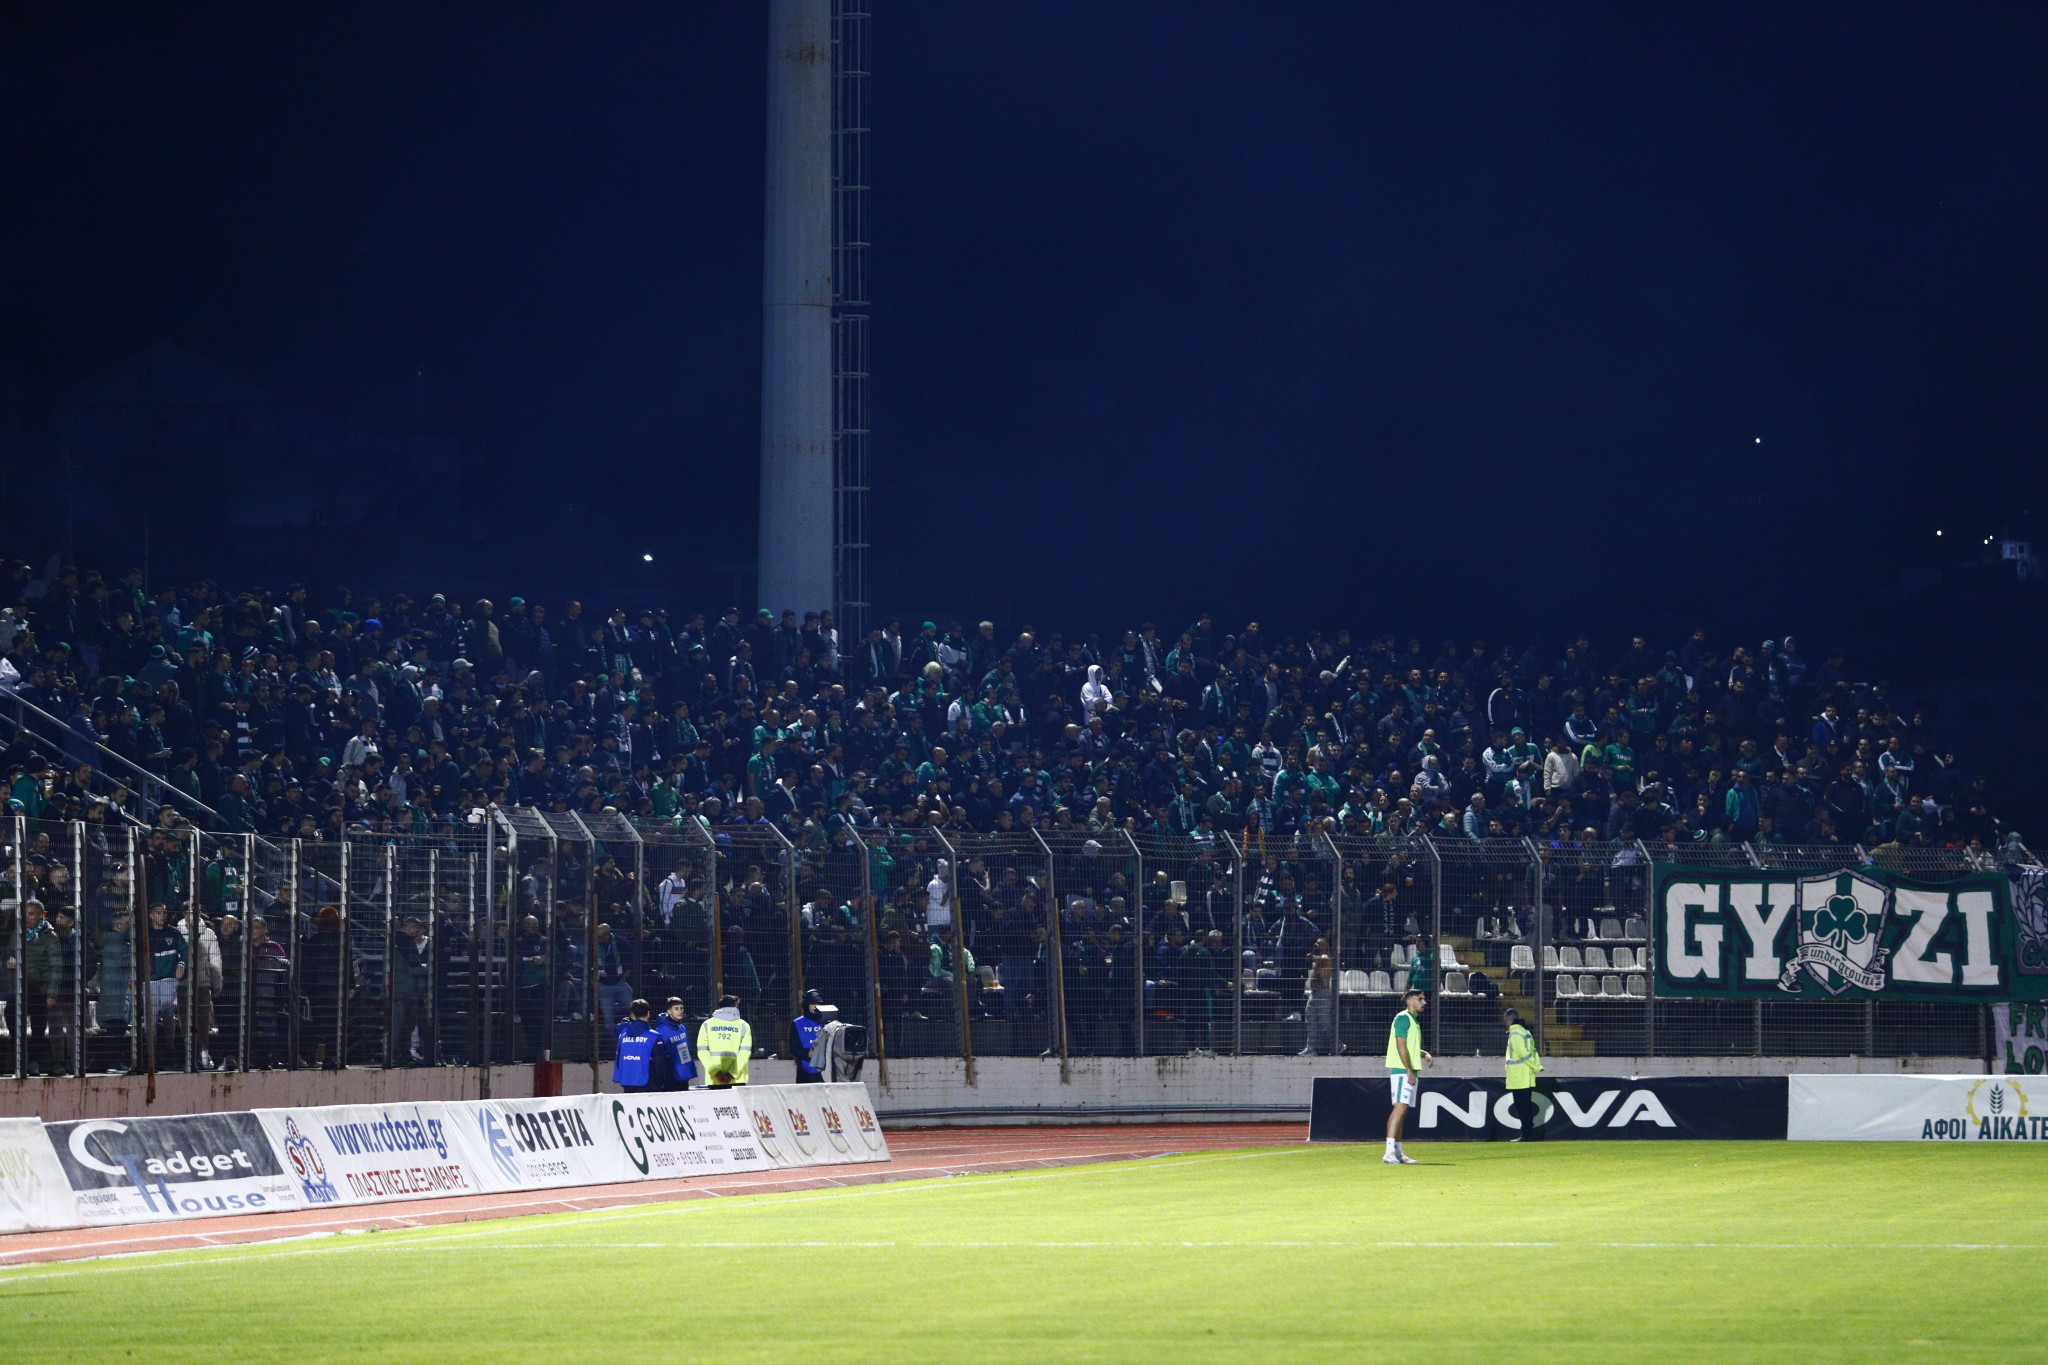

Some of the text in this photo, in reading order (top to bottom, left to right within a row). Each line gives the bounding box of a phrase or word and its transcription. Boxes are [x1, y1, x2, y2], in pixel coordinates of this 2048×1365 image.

[2008, 1003, 2048, 1039] FR
[2005, 1041, 2048, 1075] LO
[636, 1105, 696, 1143] GONIAS
[1418, 1089, 1678, 1130] NOVA
[324, 1106, 449, 1159] www.rotosal.gr
[504, 1108, 595, 1153] CORTEVA
[526, 1159, 570, 1182] agriscience
[653, 1152, 678, 1167] ENERGY
[679, 1151, 707, 1165] SYSTEMS
[346, 1165, 470, 1198] ΠΛΑΣΤΙΚΕΣ ΔΕΞΑΜΕΝΕΣ
